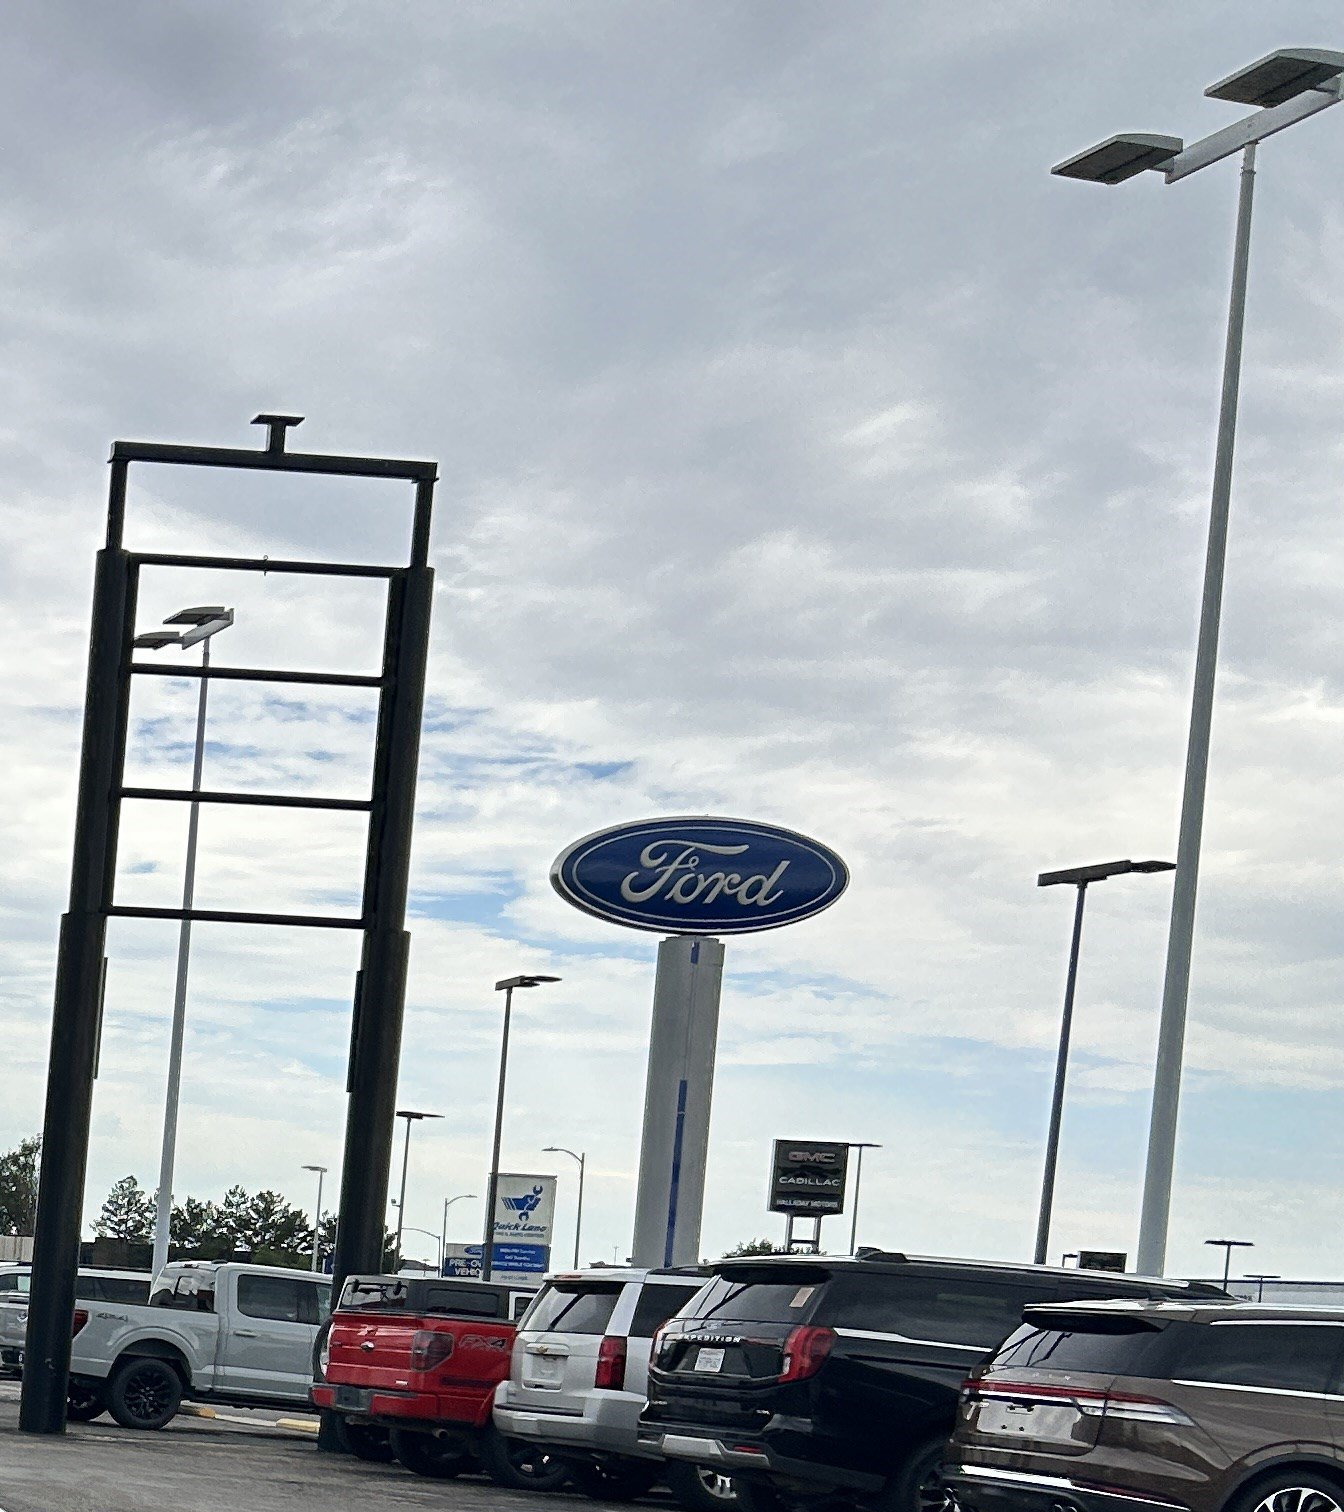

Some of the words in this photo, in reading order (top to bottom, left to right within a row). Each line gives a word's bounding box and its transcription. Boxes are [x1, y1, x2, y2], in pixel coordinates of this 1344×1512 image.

[621, 840, 790, 906] Ford
[789, 1151, 836, 1163] GMC
[779, 1176, 841, 1186] CADILLAC
